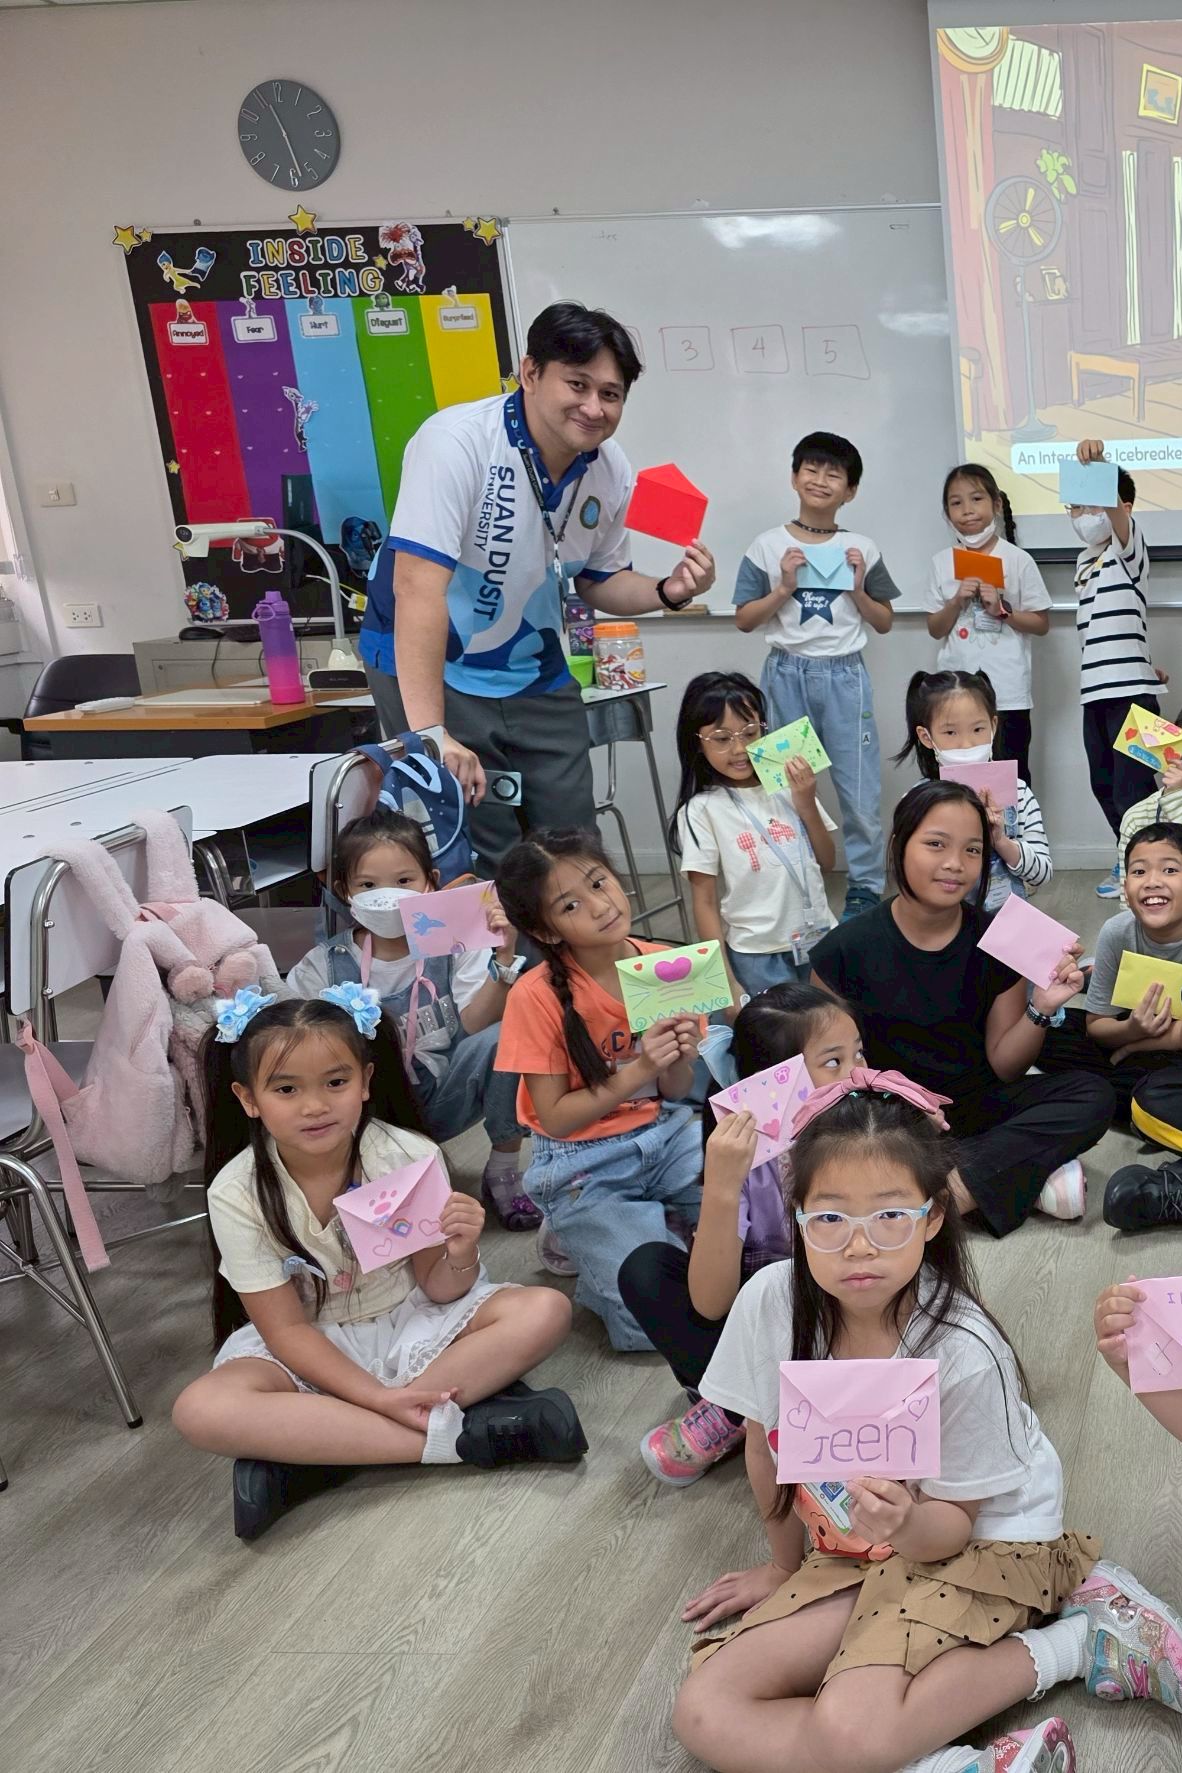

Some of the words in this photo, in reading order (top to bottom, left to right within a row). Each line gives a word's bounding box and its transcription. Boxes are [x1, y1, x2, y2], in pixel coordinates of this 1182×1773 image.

[240, 133, 258, 142] 9
[314, 129, 333, 138] 3
[250, 151, 266, 166] 8
[313, 148, 331, 160] 4
[270, 163, 280, 182] 7
[303, 161, 319, 181] 5
[248, 236, 367, 266] INSIDE
[242, 268, 383, 297] FEELING
[246, 326, 265, 334] Fear
[371, 317, 403, 329] Disgust
[173, 330, 204, 339] Annoyed
[681, 339, 699, 362] 3
[752, 336, 766, 359] 4
[822, 339, 838, 364] 5
[1018, 451, 1036, 465] An
[474, 465, 498, 552] UNIVERSITY
[490, 466, 516, 544] SUAN
[473, 550, 511, 622] DUSIT
[802, 591, 826, 603] Keep
[1167, 1292, 1176, 1305] I
[802, 1423, 918, 1466] Jeen
